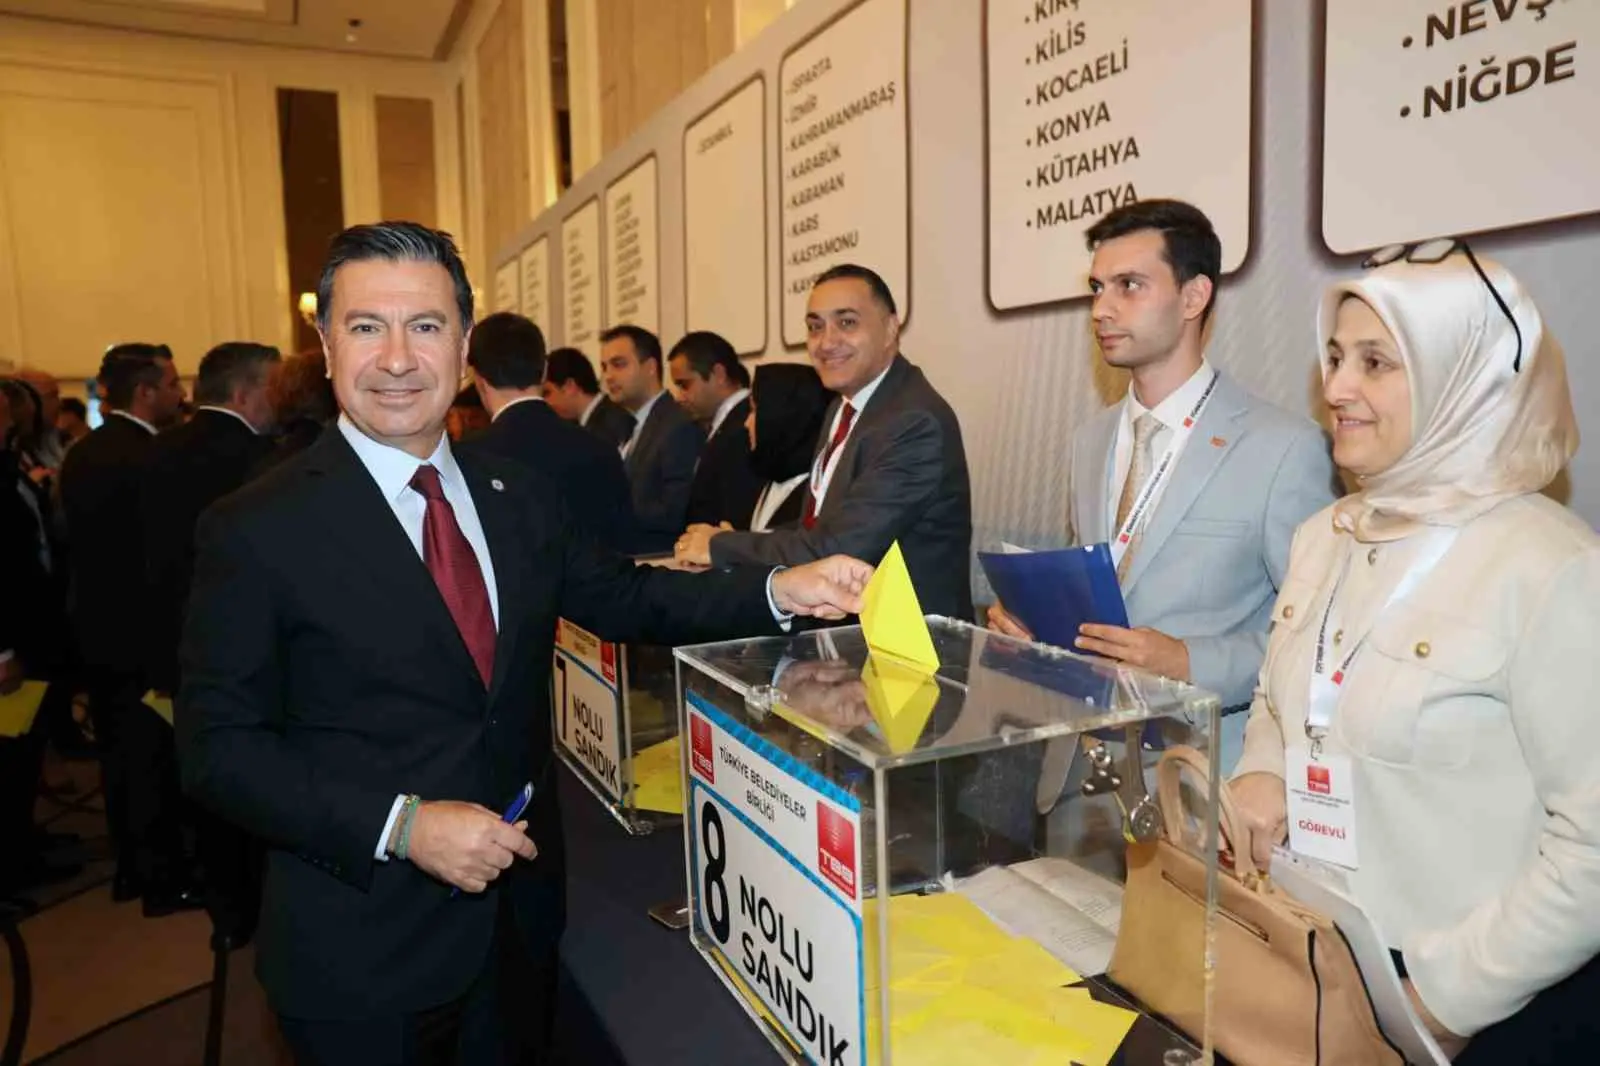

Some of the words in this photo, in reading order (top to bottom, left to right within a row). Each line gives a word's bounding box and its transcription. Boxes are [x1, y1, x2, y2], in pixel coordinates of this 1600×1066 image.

[1035, 19, 1086, 64] KİLİS
[1036, 37, 1128, 106] KOCAELİ
[1423, 40, 1577, 118] NİĞDE
[790, 80, 896, 151] KAHRAMANMARAŞ
[1036, 100, 1111, 147] KONYA
[1037, 136, 1140, 188] KÜTAHYA
[791, 172, 846, 207] KARAMAN
[1037, 181, 1138, 229] MALATYA
[792, 230, 860, 265] KASTAMONU
[573, 695, 604, 741] NOLU
[574, 728, 619, 792] SANDIK
[1299, 817, 1347, 840] GÖREVLİ
[701, 800, 730, 944] 8
[739, 874, 813, 983] NOLU
[742, 930, 849, 1066] SANDIK
